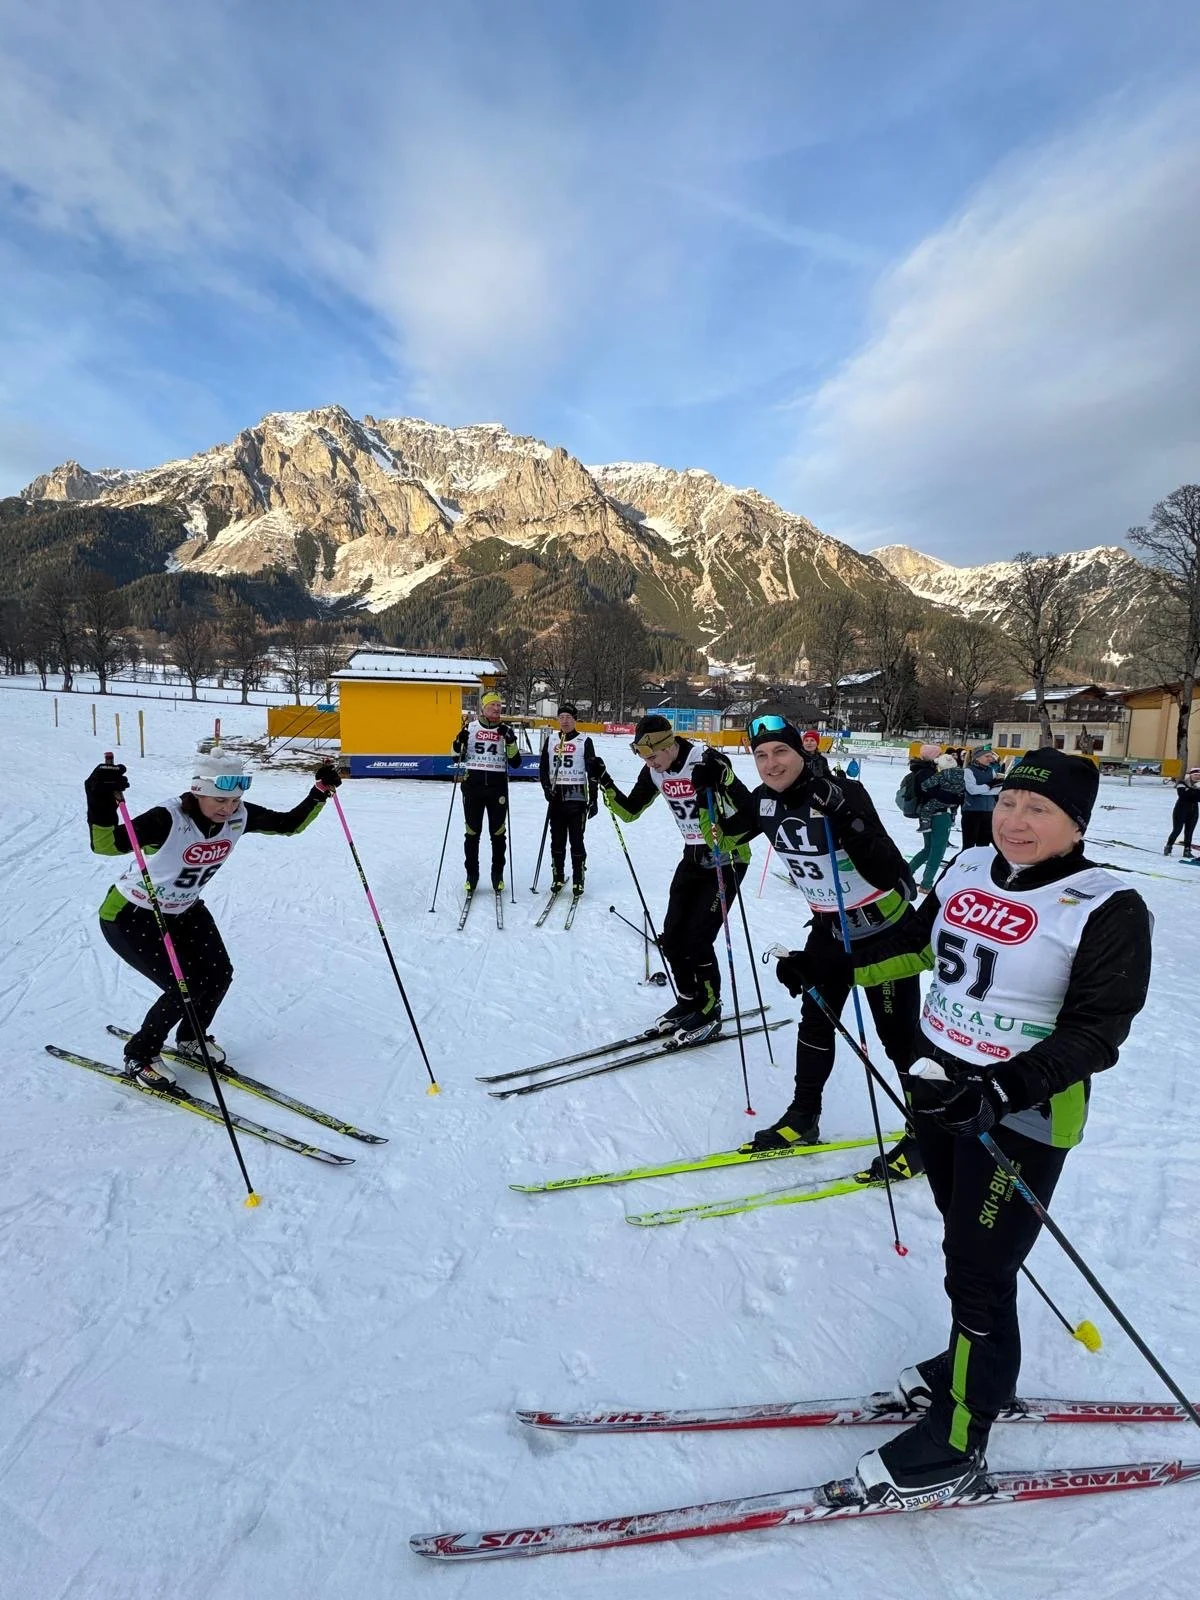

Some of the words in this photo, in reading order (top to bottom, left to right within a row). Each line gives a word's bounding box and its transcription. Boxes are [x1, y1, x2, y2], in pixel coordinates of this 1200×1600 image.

[477, 731, 498, 741] Spitz
[475, 742, 498, 755] 54
[555, 743, 574, 753] Sitz
[553, 754, 574, 768] 55
[1015, 766, 1052, 780] BIKE
[663, 781, 694, 797] Spitz
[669, 799, 699, 820] 52
[188, 845, 229, 863] Spitz
[173, 863, 223, 889] 56
[786, 858, 824, 880] 53
[951, 893, 1027, 938] Spitz
[936, 928, 999, 1002] 51
[881, 980, 892, 995] BIK
[948, 1030, 971, 1045] Spitz
[979, 1042, 1008, 1058] Spitz
[750, 1149, 795, 1160] FISCHER
[979, 1200, 999, 1229] SKI
[989, 1160, 1014, 1196] BIK
